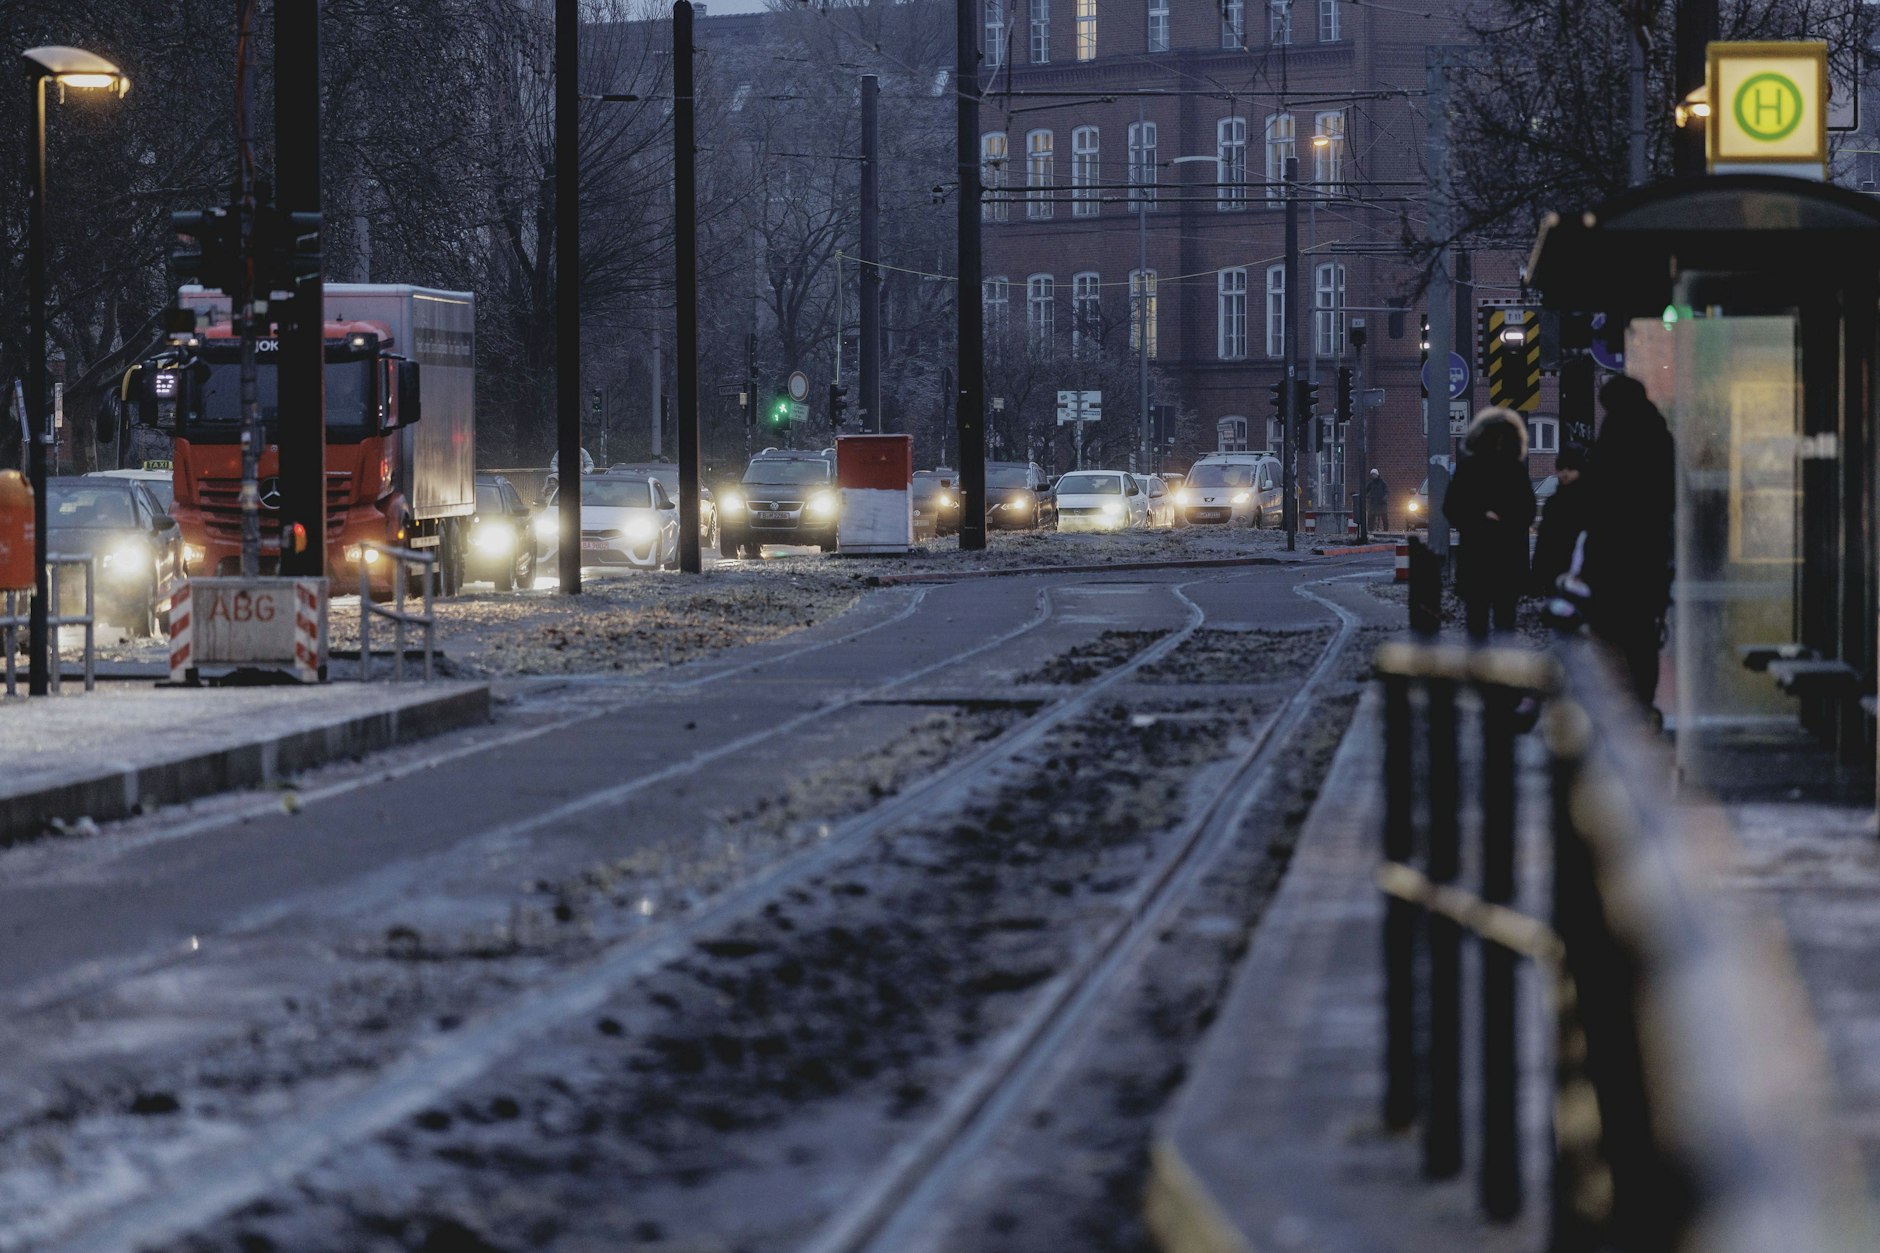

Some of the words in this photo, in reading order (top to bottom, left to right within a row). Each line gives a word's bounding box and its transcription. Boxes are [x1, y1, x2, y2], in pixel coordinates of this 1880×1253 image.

[1756, 88, 1782, 126] H
[149, 461, 169, 469] TAXI
[208, 593, 275, 623] ABG
